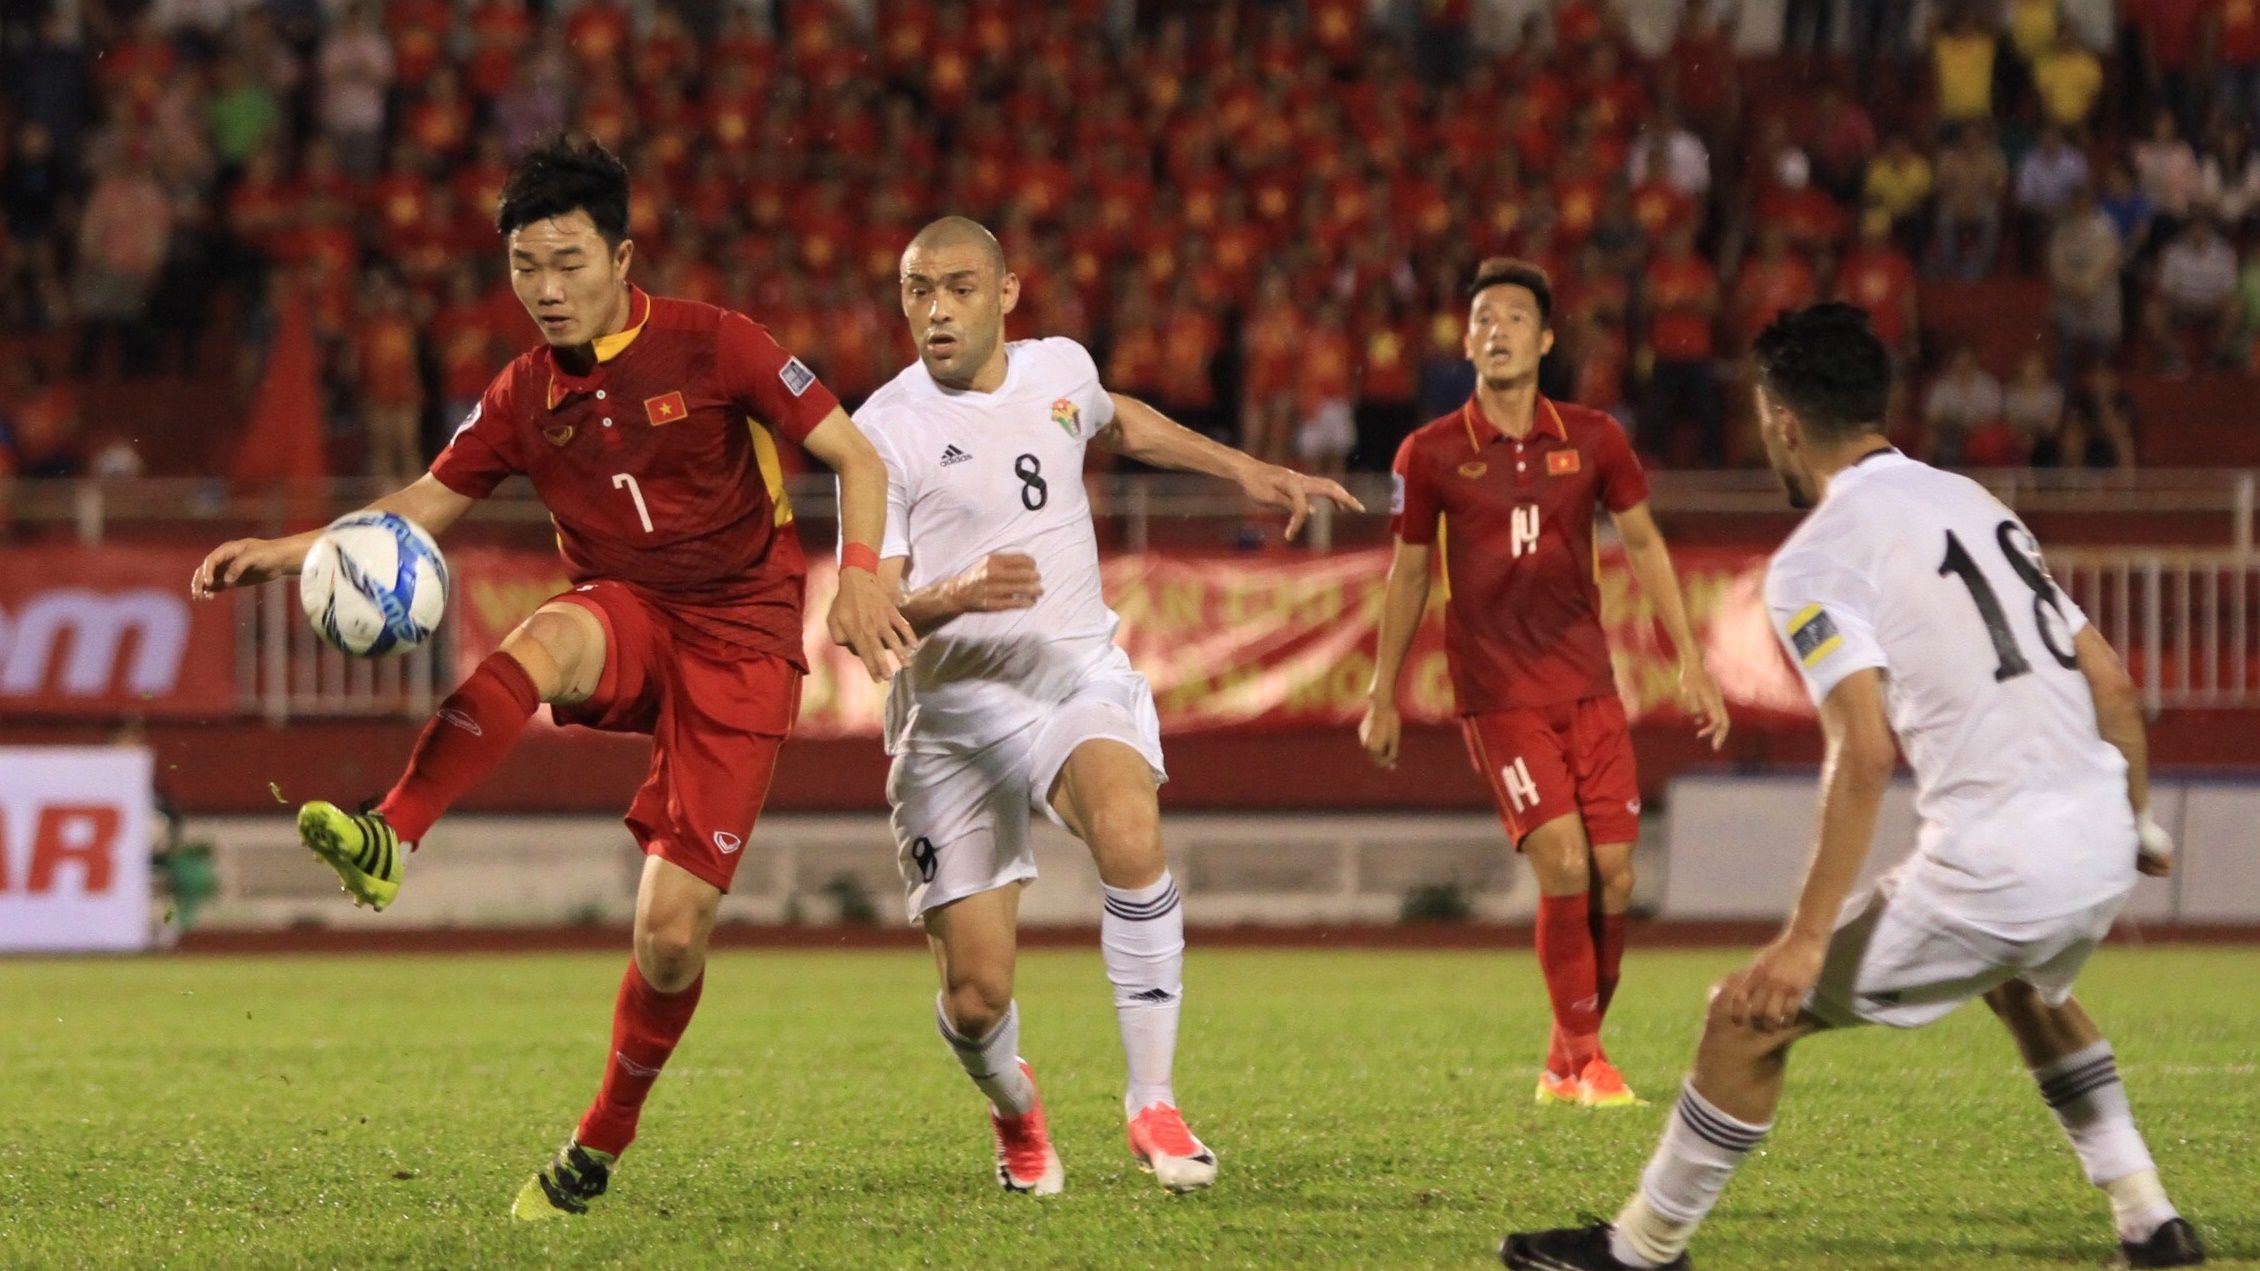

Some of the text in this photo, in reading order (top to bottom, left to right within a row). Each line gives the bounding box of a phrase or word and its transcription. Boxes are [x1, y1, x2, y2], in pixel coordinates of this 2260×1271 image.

[940, 454, 973, 467] adidas
[1015, 453, 1047, 511] 8
[612, 473, 654, 533] 7
[1510, 504, 1539, 558] 14
[1937, 519, 2078, 683] 18
[0, 586, 191, 697] m
[1502, 757, 1540, 813] 14
[0, 804, 121, 894] R
[911, 836, 938, 884] 8
